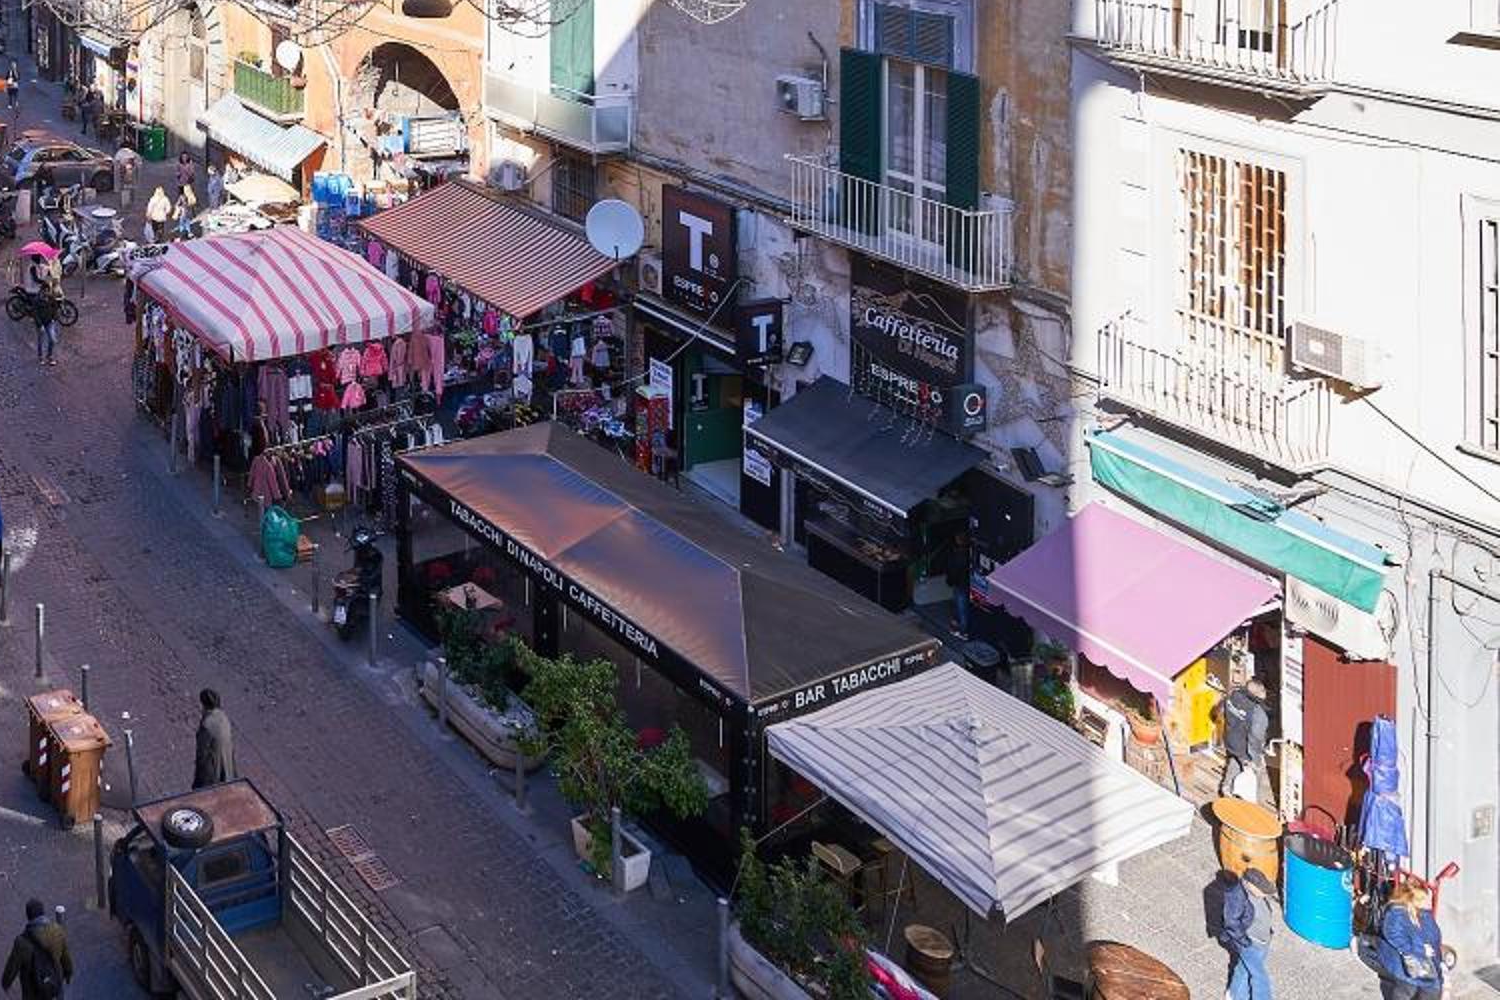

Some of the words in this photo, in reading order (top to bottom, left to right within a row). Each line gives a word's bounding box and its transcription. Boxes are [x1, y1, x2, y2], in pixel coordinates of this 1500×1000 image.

[679, 210, 713, 272] T
[752, 315, 772, 352] T
[865, 307, 958, 361] Caffetteria
[450, 499, 503, 546] TABACCHI
[507, 540, 519, 558] DI
[519, 552, 563, 591] NAPOLI
[569, 584, 659, 659] CAFFETTERIA
[795, 685, 826, 709] BAR
[832, 657, 902, 695] TABACCHI
